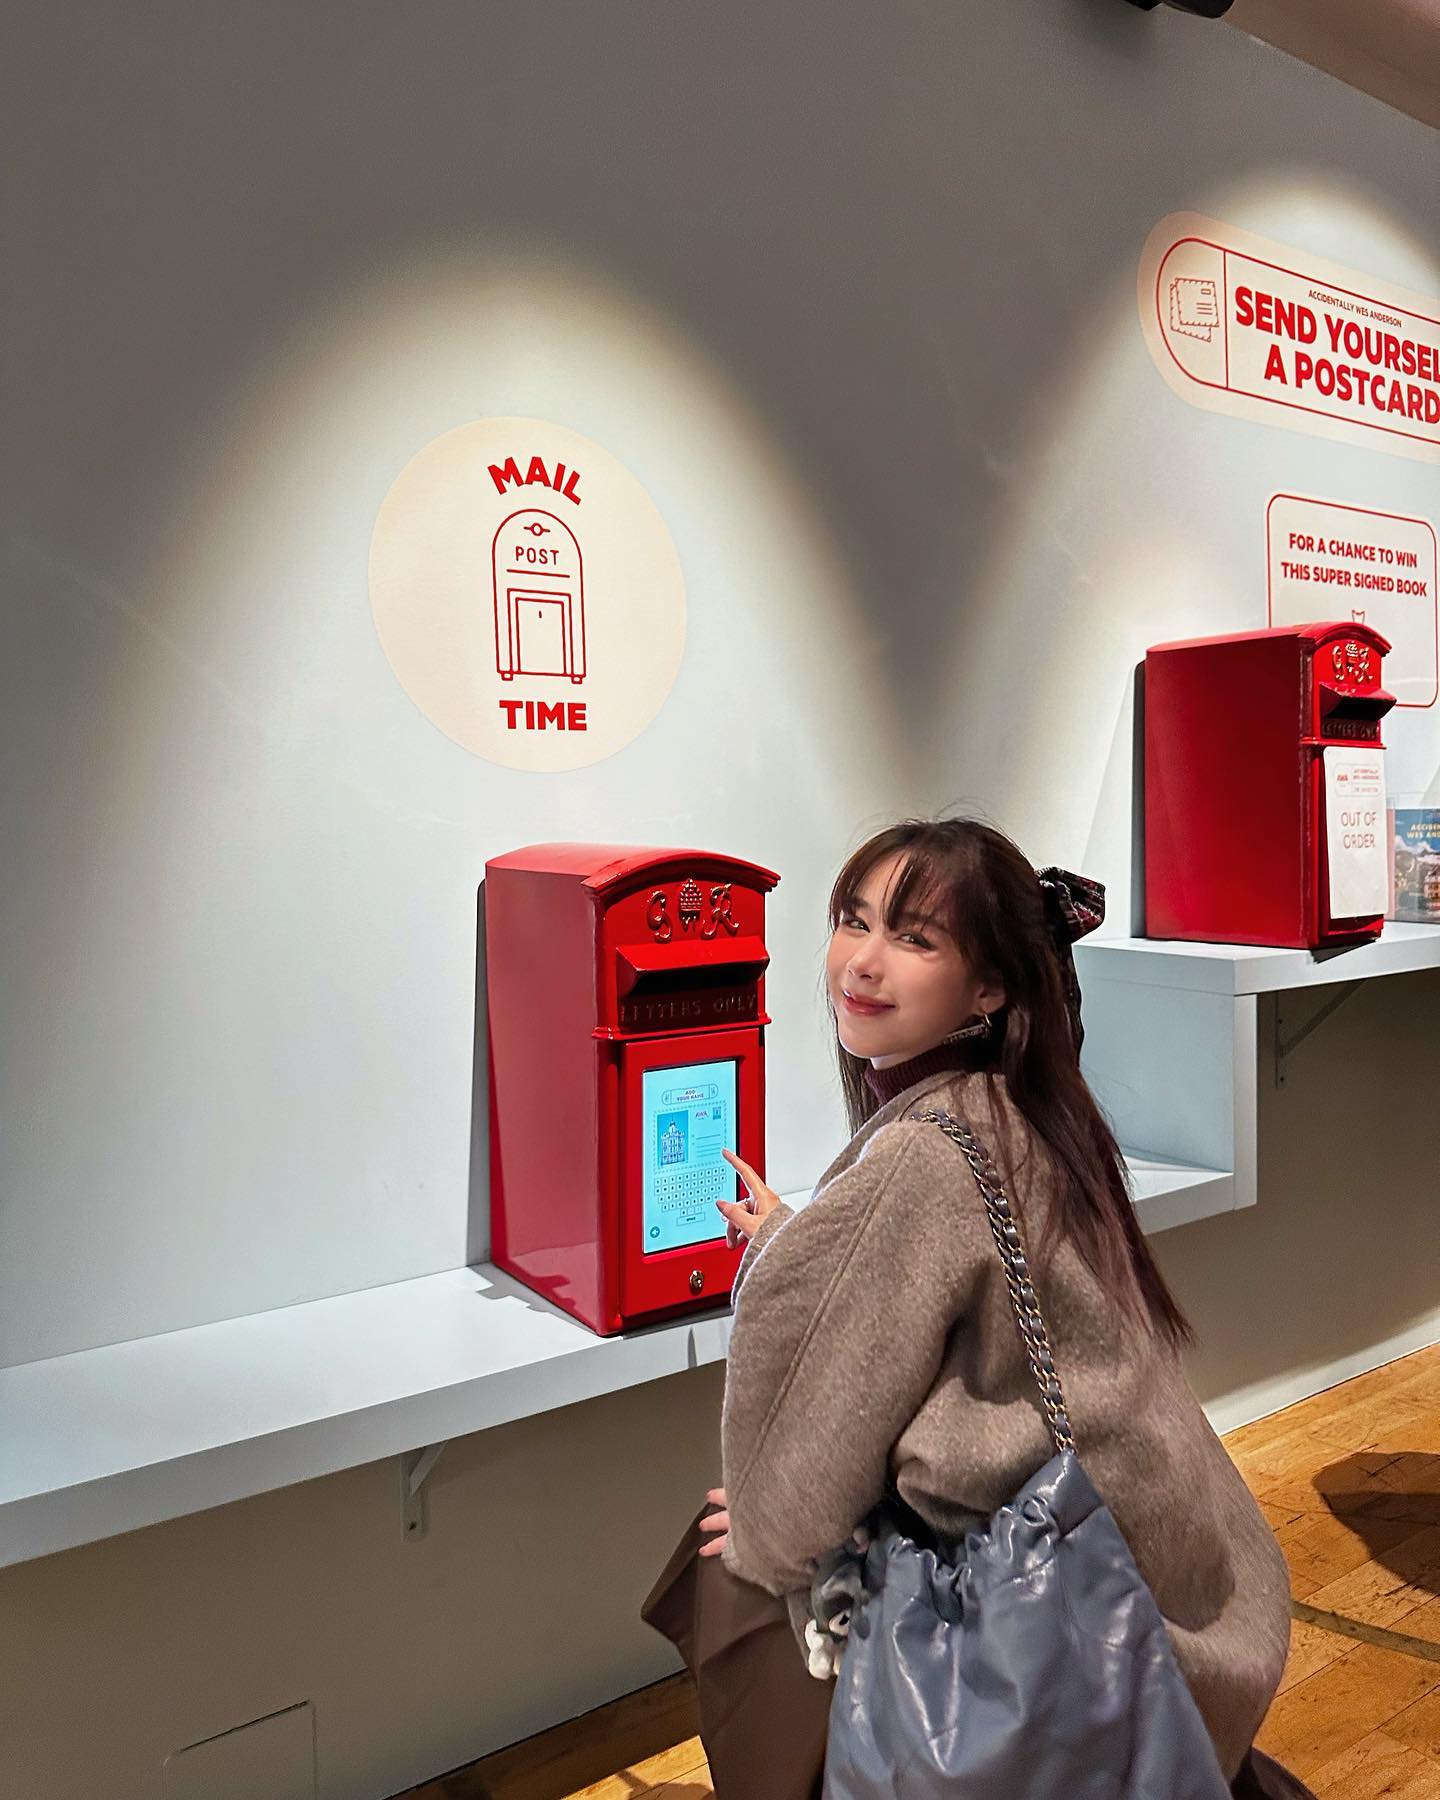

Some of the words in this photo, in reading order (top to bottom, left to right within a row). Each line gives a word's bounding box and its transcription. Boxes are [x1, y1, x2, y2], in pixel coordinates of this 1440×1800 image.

[1308, 290, 1354, 313] ACCIDENTALLY
[1356, 303, 1369, 317] WES
[1370, 310, 1402, 328] ANDERSON
[1235, 286, 1317, 345] SEND
[1324, 314, 1440, 383] YOURSEL
[1264, 344, 1288, 385] A
[1295, 351, 1440, 424] POSTCARD
[487, 456, 581, 506] MAIL
[515, 546, 559, 565] POST
[1289, 533, 1314, 552] FOR
[1317, 538, 1326, 554] A
[1329, 540, 1376, 561] CHANCE
[1378, 548, 1393, 564] TO
[1395, 550, 1417, 568] WIN
[1281, 562, 1310, 581] THIS
[1313, 566, 1351, 587] SUPER
[1354, 573, 1394, 592] SIGNED
[1397, 579, 1427, 597] BOOK
[499, 700, 587, 731] TIME
[1340, 812, 1361, 828] OUT
[1363, 812, 1377, 826] OF
[1343, 834, 1376, 849] ORDER
